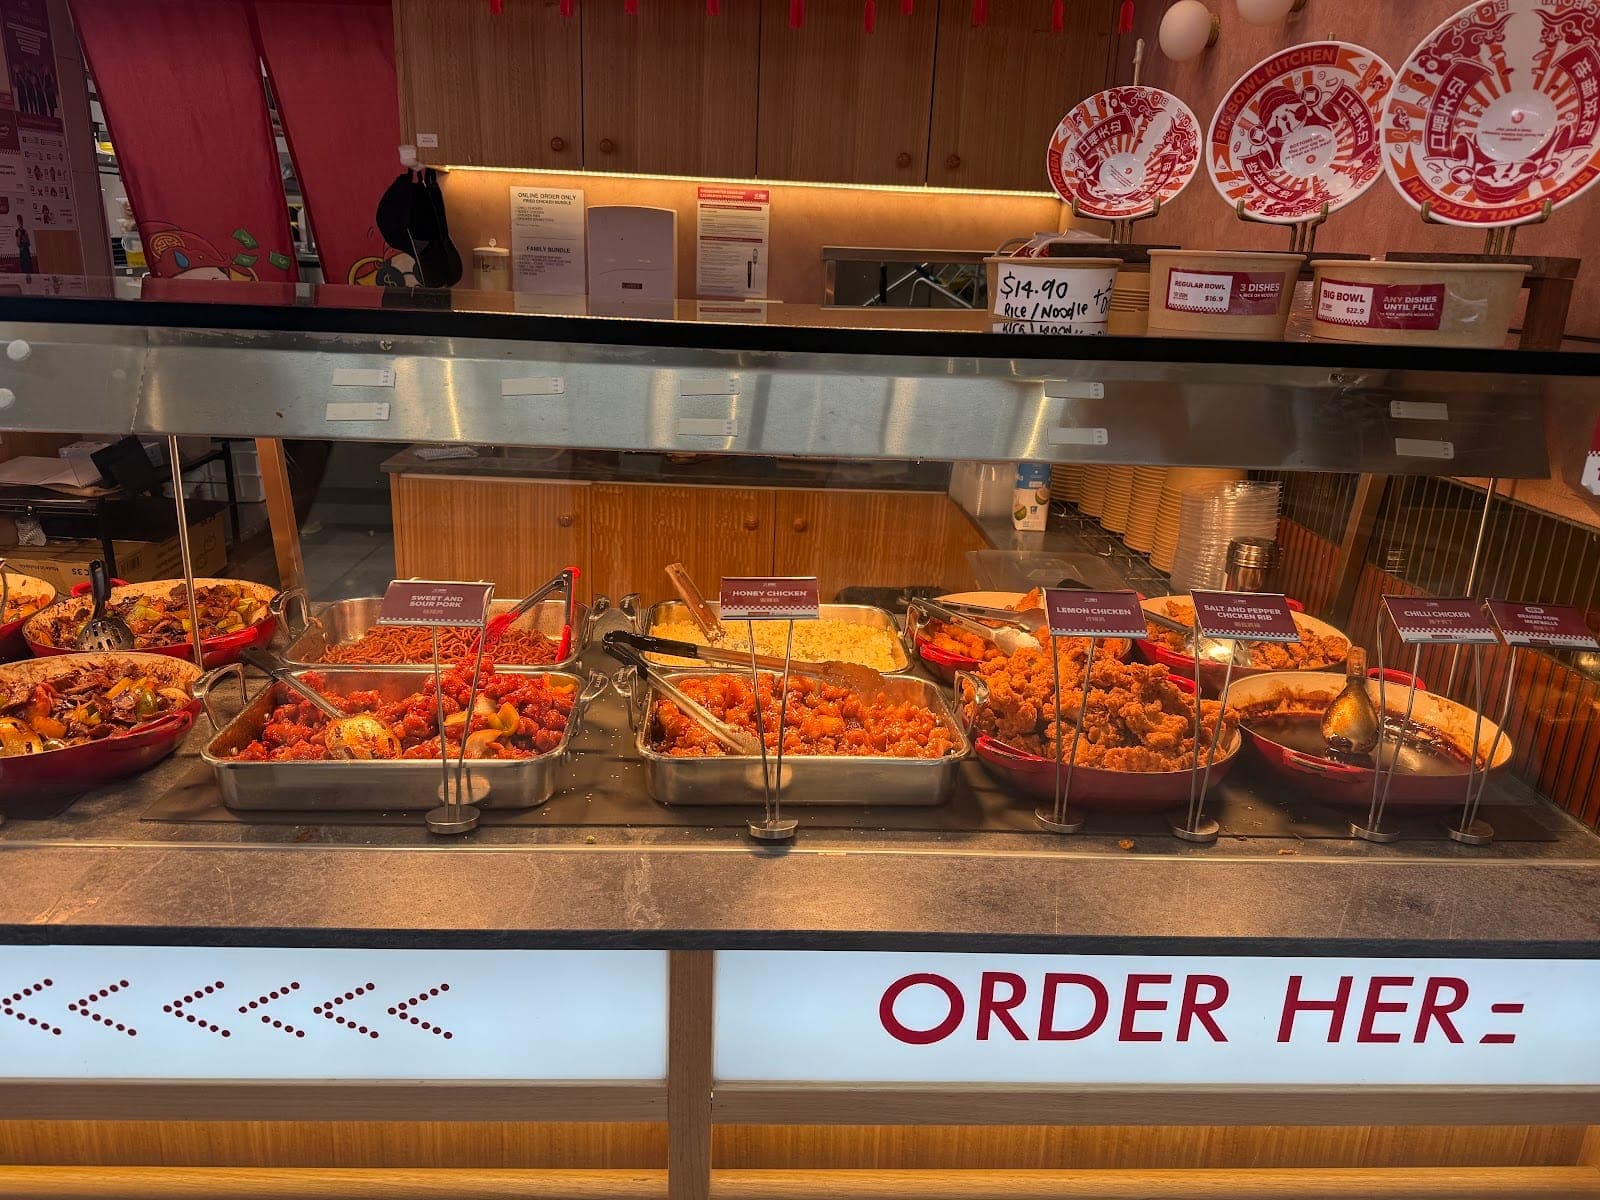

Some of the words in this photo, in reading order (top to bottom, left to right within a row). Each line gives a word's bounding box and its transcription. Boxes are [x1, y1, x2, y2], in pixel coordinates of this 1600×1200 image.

[1452, 13, 1476, 35] JOY
[1149, 92, 1169, 106] BIG
[1215, 116, 1236, 141] BIG
[1228, 75, 1266, 116] BOWL
[1265, 51, 1335, 80] KITCHEN
[1431, 75, 1467, 150] 口福无边
[1050, 152, 1072, 198] KITCHEN
[1556, 170, 1594, 199] BIG
[1404, 180, 1481, 220] KITCHEN
[1486, 200, 1545, 221] BOWL
[1000, 271, 1068, 300] $14.90
[1175, 280, 1204, 289] REGULAR
[1240, 283, 1247, 292] 3
[1248, 283, 1280, 292] DISHES
[1323, 289, 1335, 300] BIG
[1336, 292, 1366, 303] BOWL
[1383, 295, 1402, 303] ANY
[1404, 296, 1437, 304] DISHES
[1346, 306, 1365, 315] $22.9
[1383, 303, 1411, 311] UNTIL
[1412, 303, 1434, 311] FULL
[1056, 606, 1090, 615] LEMON
[1090, 607, 1132, 615] CHICKEN
[1203, 604, 1225, 612] SALT
[1246, 607, 1282, 615] PEPPER
[1217, 612, 1256, 620] CHICKEN
[879, 971, 1229, 1045] ORDER
